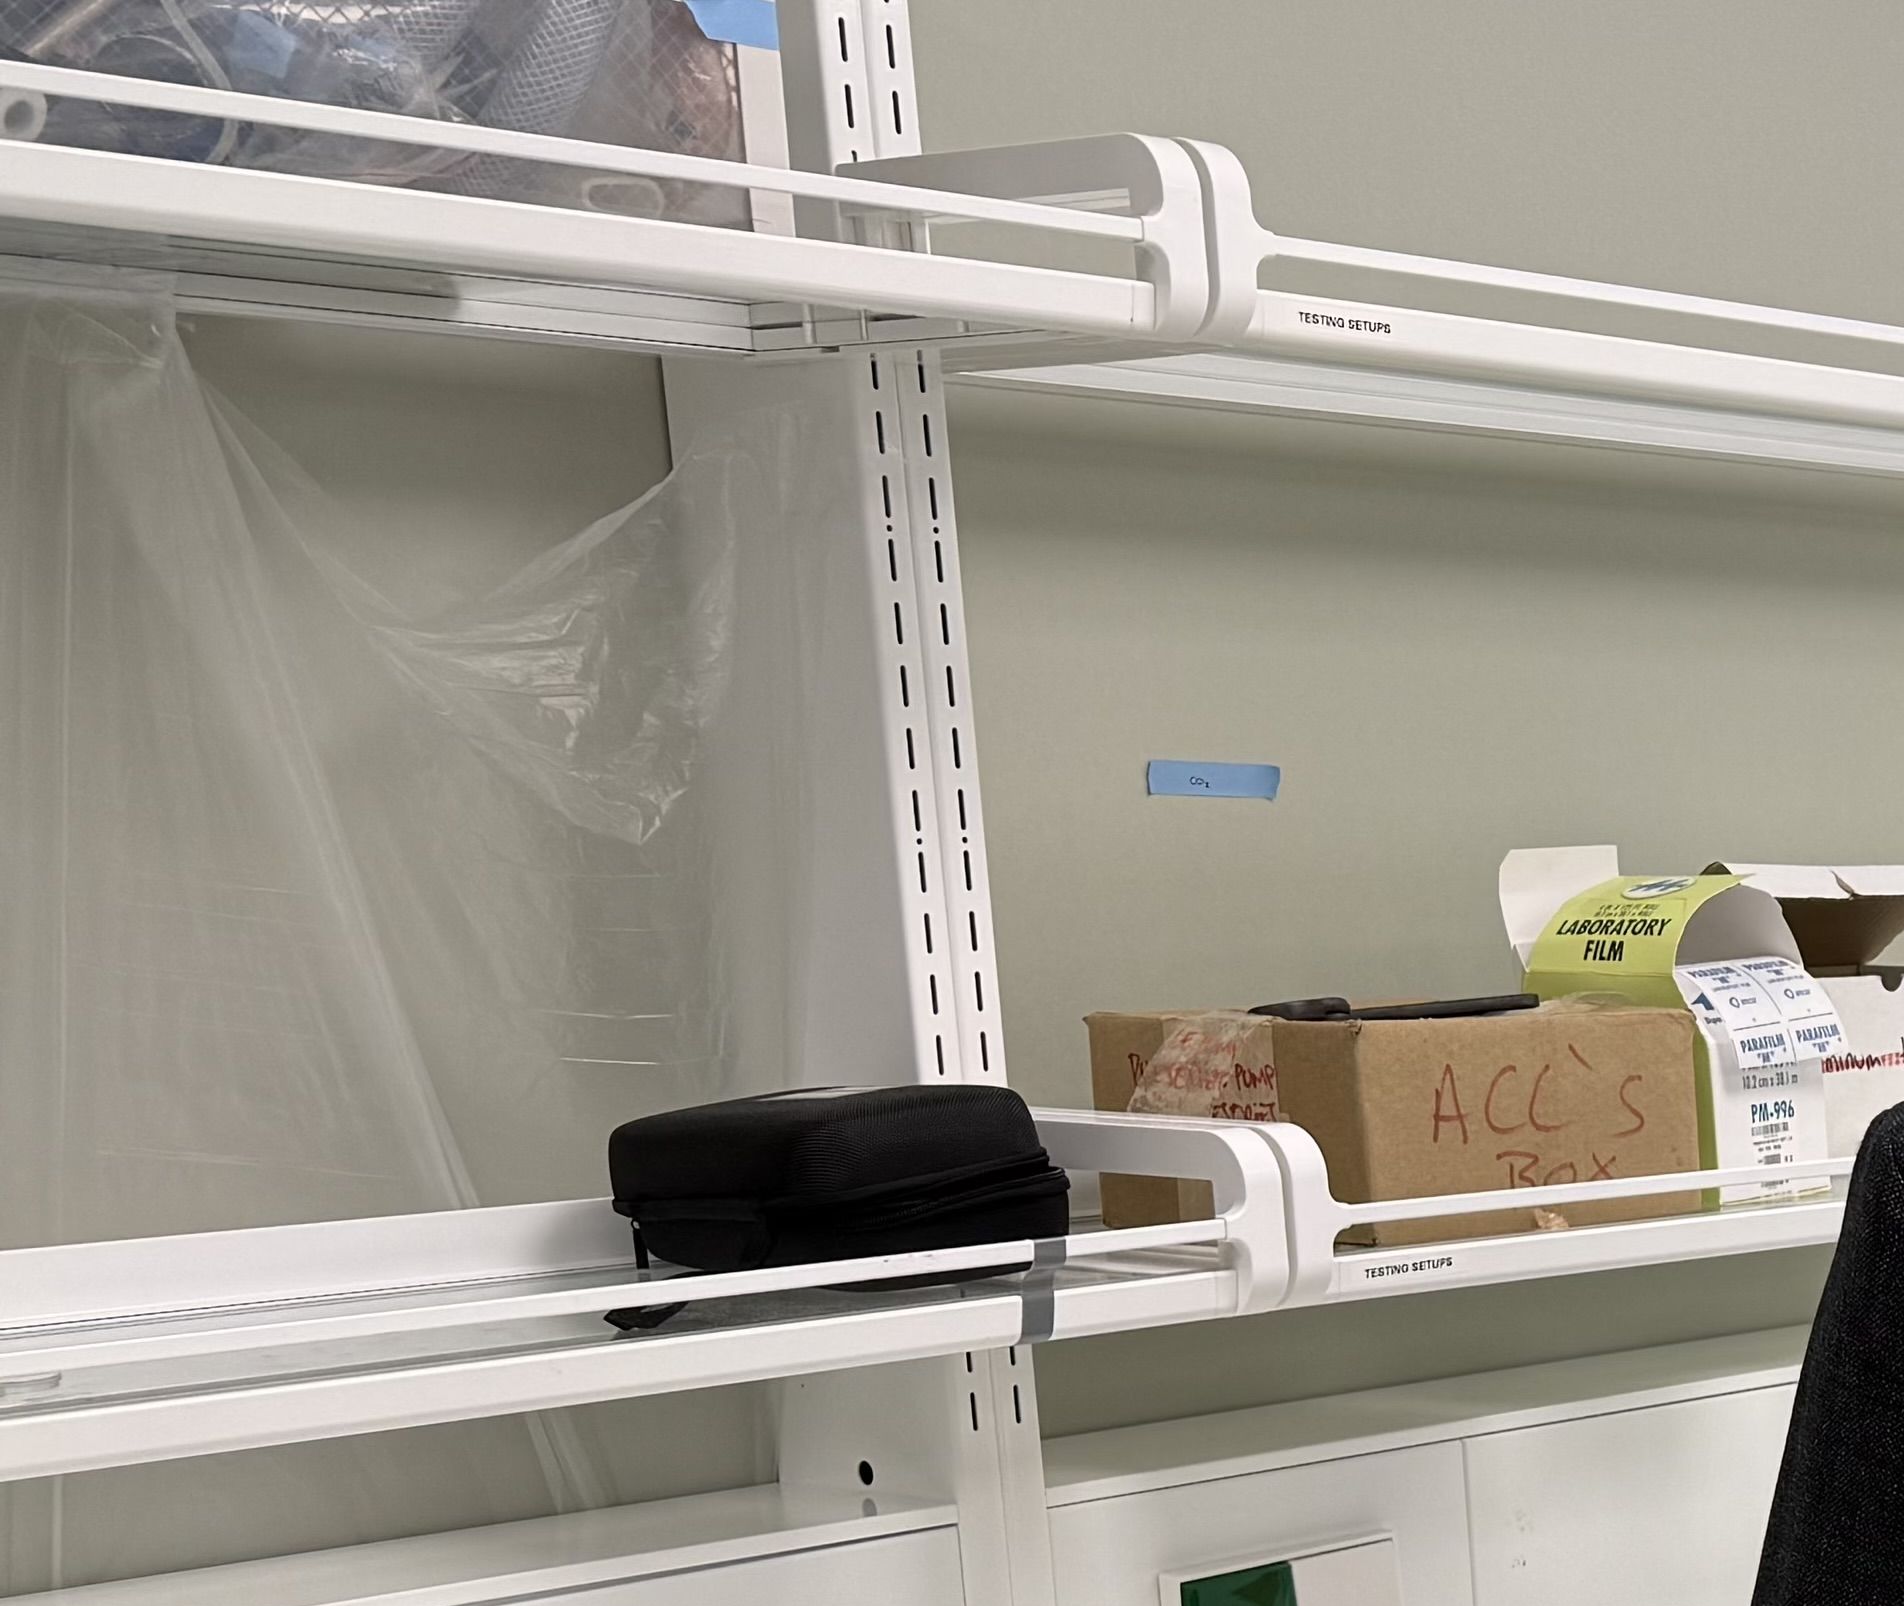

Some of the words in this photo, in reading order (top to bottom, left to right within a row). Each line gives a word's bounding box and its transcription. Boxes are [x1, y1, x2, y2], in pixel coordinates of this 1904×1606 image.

[1298, 311, 1345, 328] TESTING
[1348, 319, 1391, 334] SETUPS
[1556, 918, 1672, 936] LABORATORY
[1583, 939, 1625, 961] FILM
[1739, 1033, 1786, 1053] PARAFILM
[1795, 1023, 1840, 1044] PARAFILM
[1496, 1150, 1616, 1189] BOX
[1365, 1263, 1409, 1279] TESTING
[1411, 1256, 1453, 1272] SETUPS
